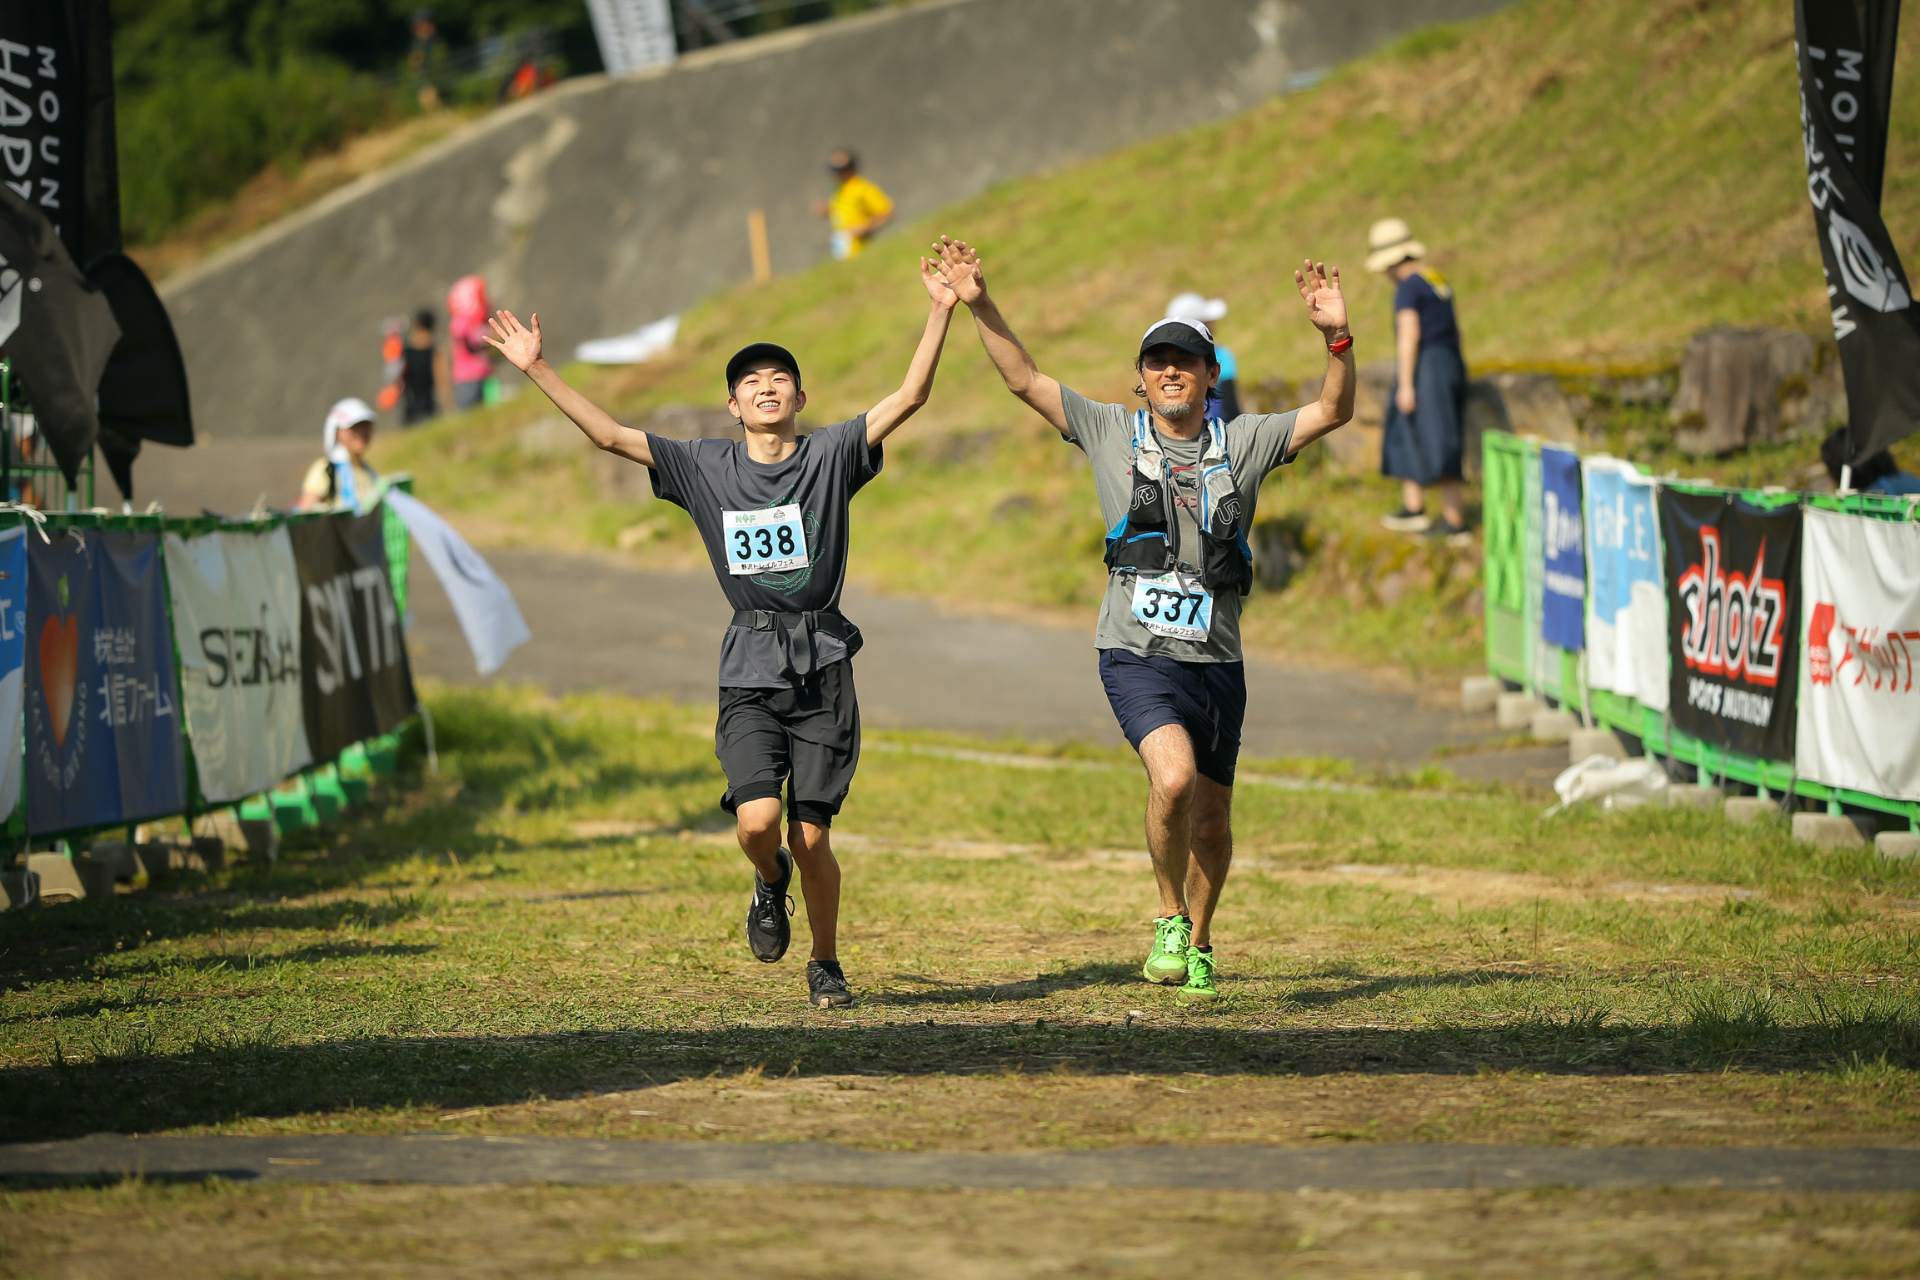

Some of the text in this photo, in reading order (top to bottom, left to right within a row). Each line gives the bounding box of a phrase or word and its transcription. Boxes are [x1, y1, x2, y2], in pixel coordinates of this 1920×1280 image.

[734, 525, 795, 560] 338
[741, 558, 795, 571] 野沢トレイルフェス
[1142, 587, 1204, 625] 337
